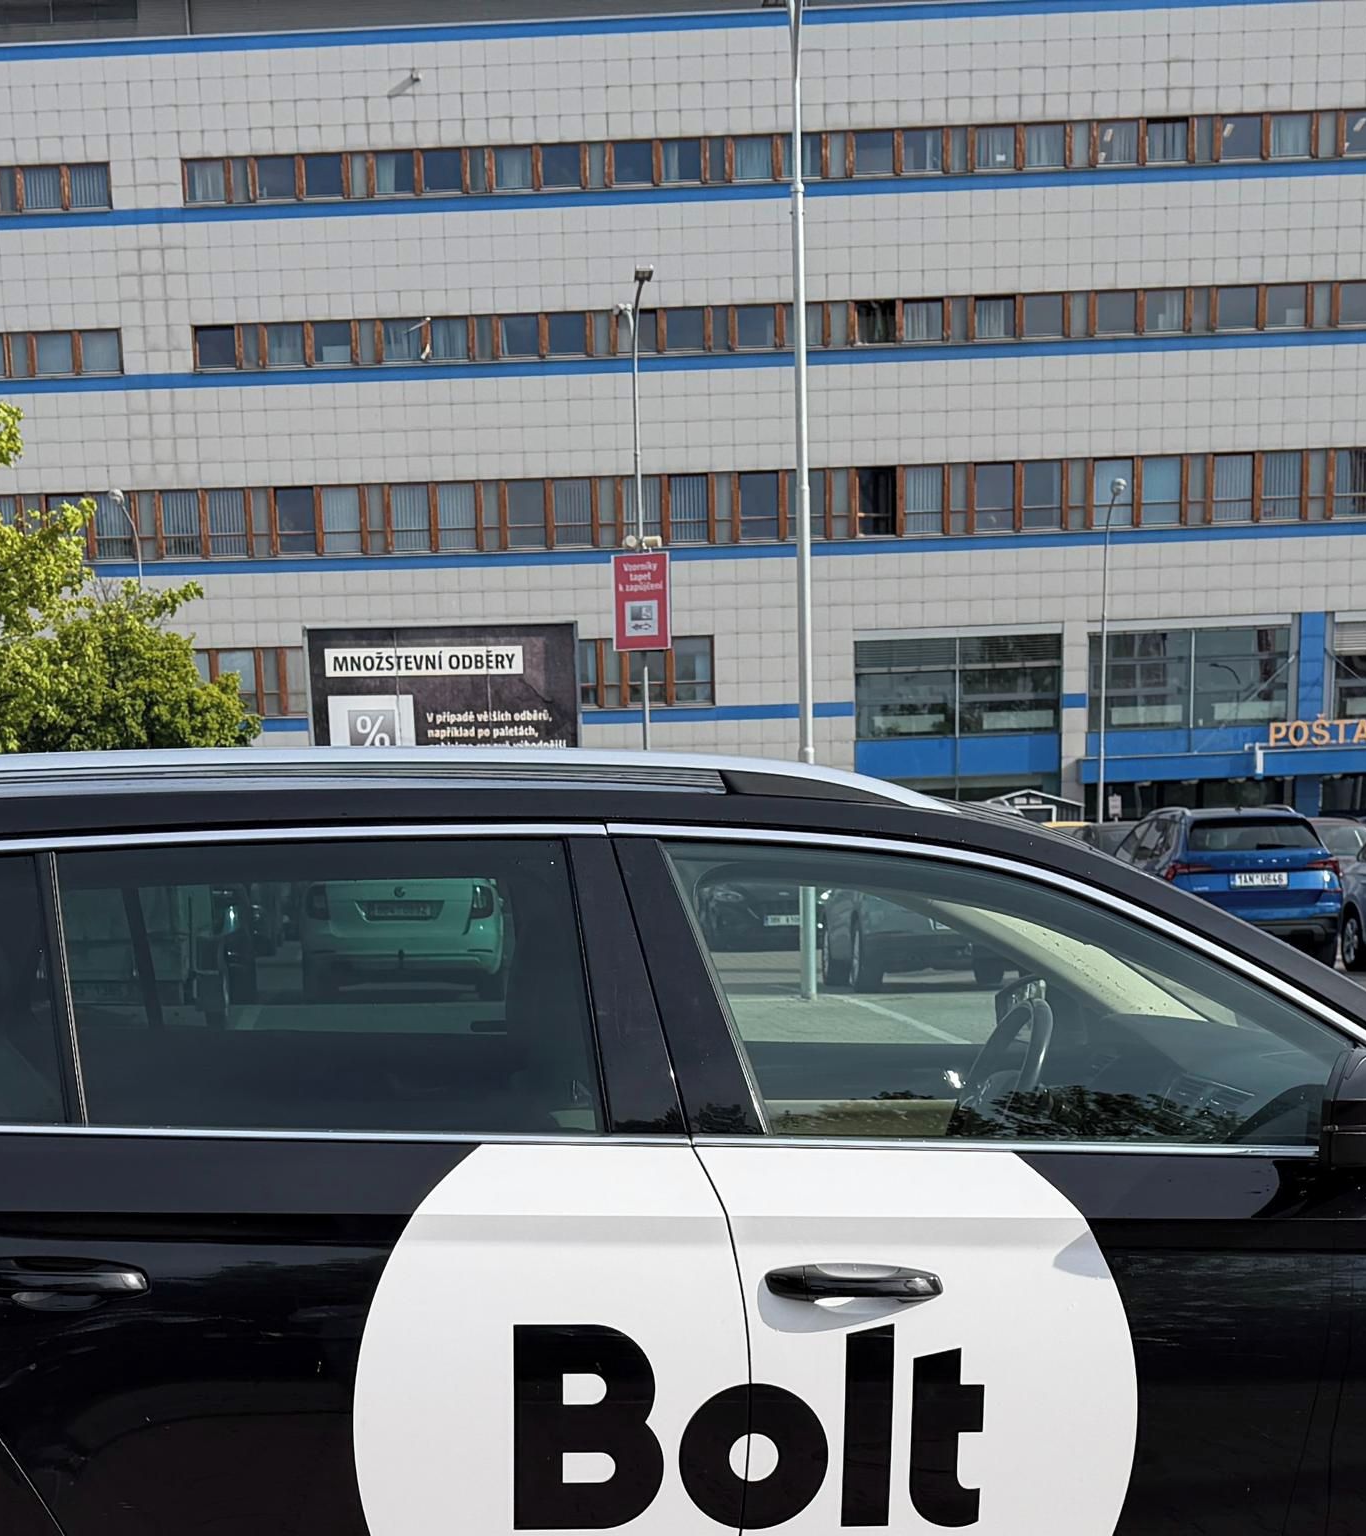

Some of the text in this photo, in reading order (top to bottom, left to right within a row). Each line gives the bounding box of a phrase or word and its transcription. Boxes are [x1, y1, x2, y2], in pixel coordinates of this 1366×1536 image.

[332, 650, 515, 672] MNOŽSTEVNÍ ODBĚRY
[426, 712, 433, 722] V
[477, 728, 491, 739] po
[513, 1324, 985, 1530] Bolt
